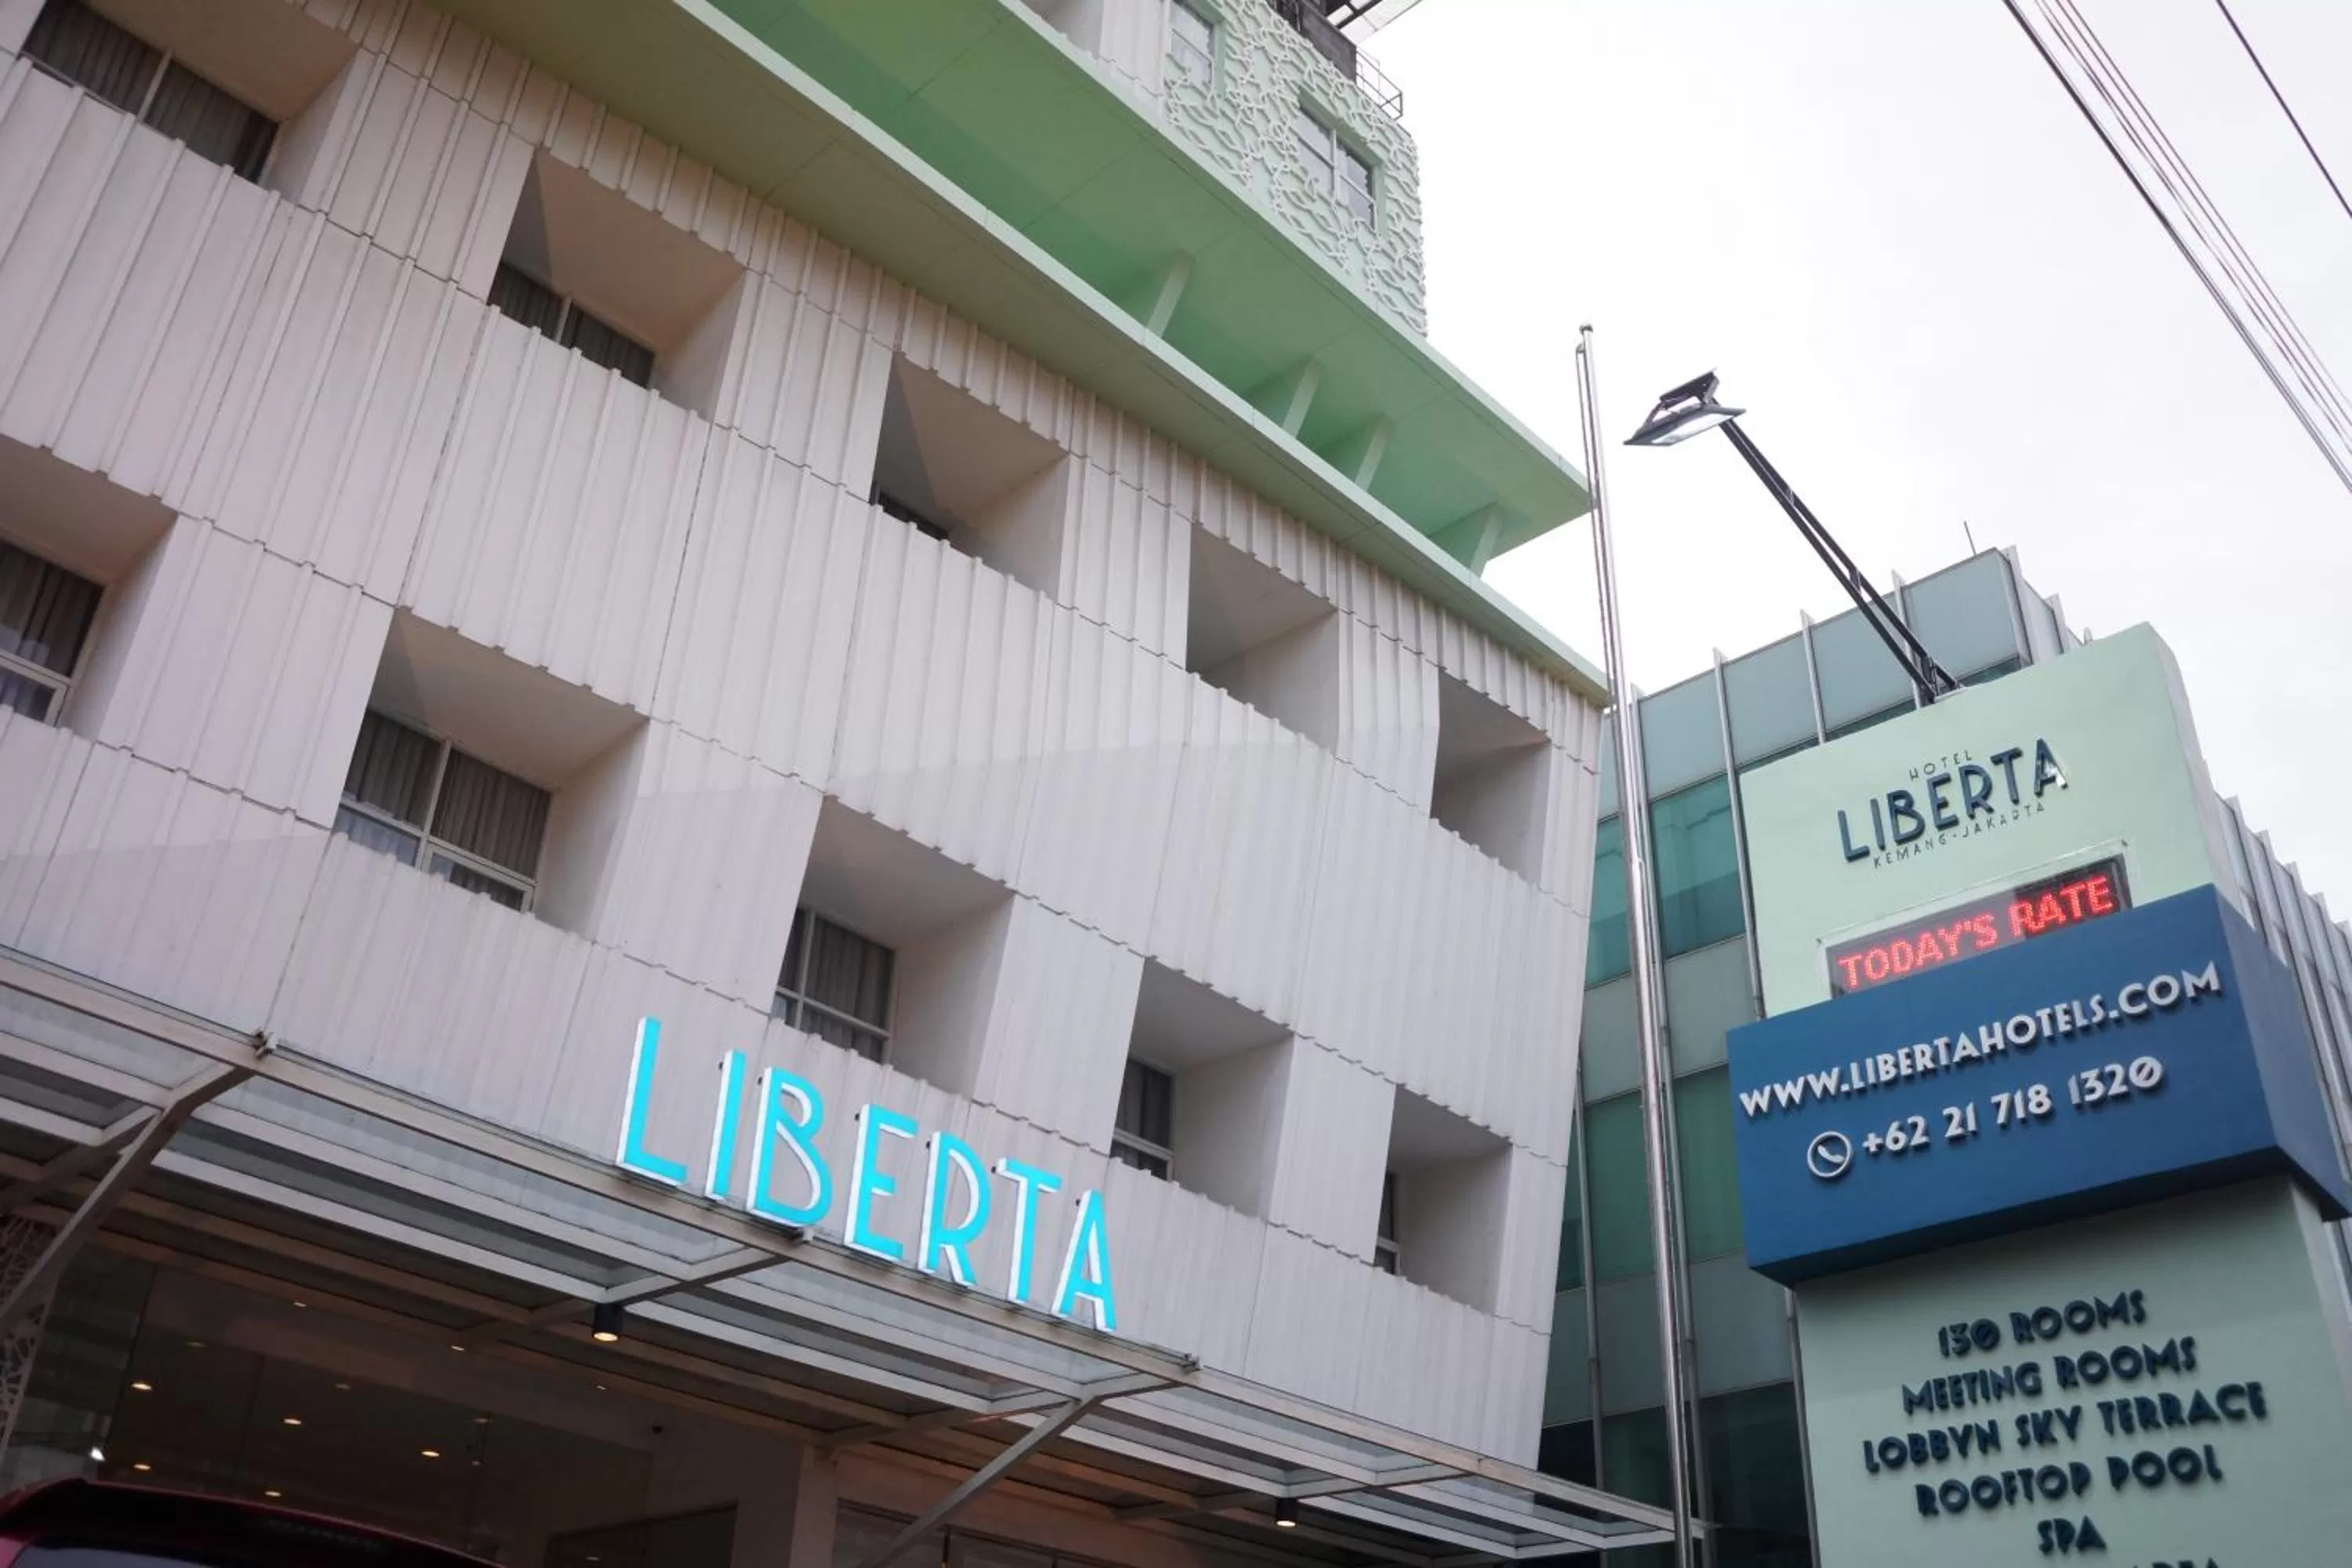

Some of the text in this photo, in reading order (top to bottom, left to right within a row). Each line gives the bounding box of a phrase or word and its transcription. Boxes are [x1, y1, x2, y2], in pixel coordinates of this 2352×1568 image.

[1837, 738, 2070, 863] LIBERTA
[1909, 750, 1973, 782] HOTEL
[1838, 873, 2114, 991] TODAY'S RATE
[1740, 960, 2222, 1118] WWW.LIBERTAHOTELS.COM
[1861, 1055, 2165, 1156] +62 21 718 1320
[615, 1017, 1116, 1332] LIBERTA
[2009, 1289, 2148, 1345] ROOMS
[1901, 1336, 2198, 1416] MEETING ROOMS
[1862, 1381, 2269, 1474] LOBBYN SKY TERRACE
[1915, 1443, 2223, 1517] ROOFTOP POOL
[2037, 1515, 2107, 1555] SPA
